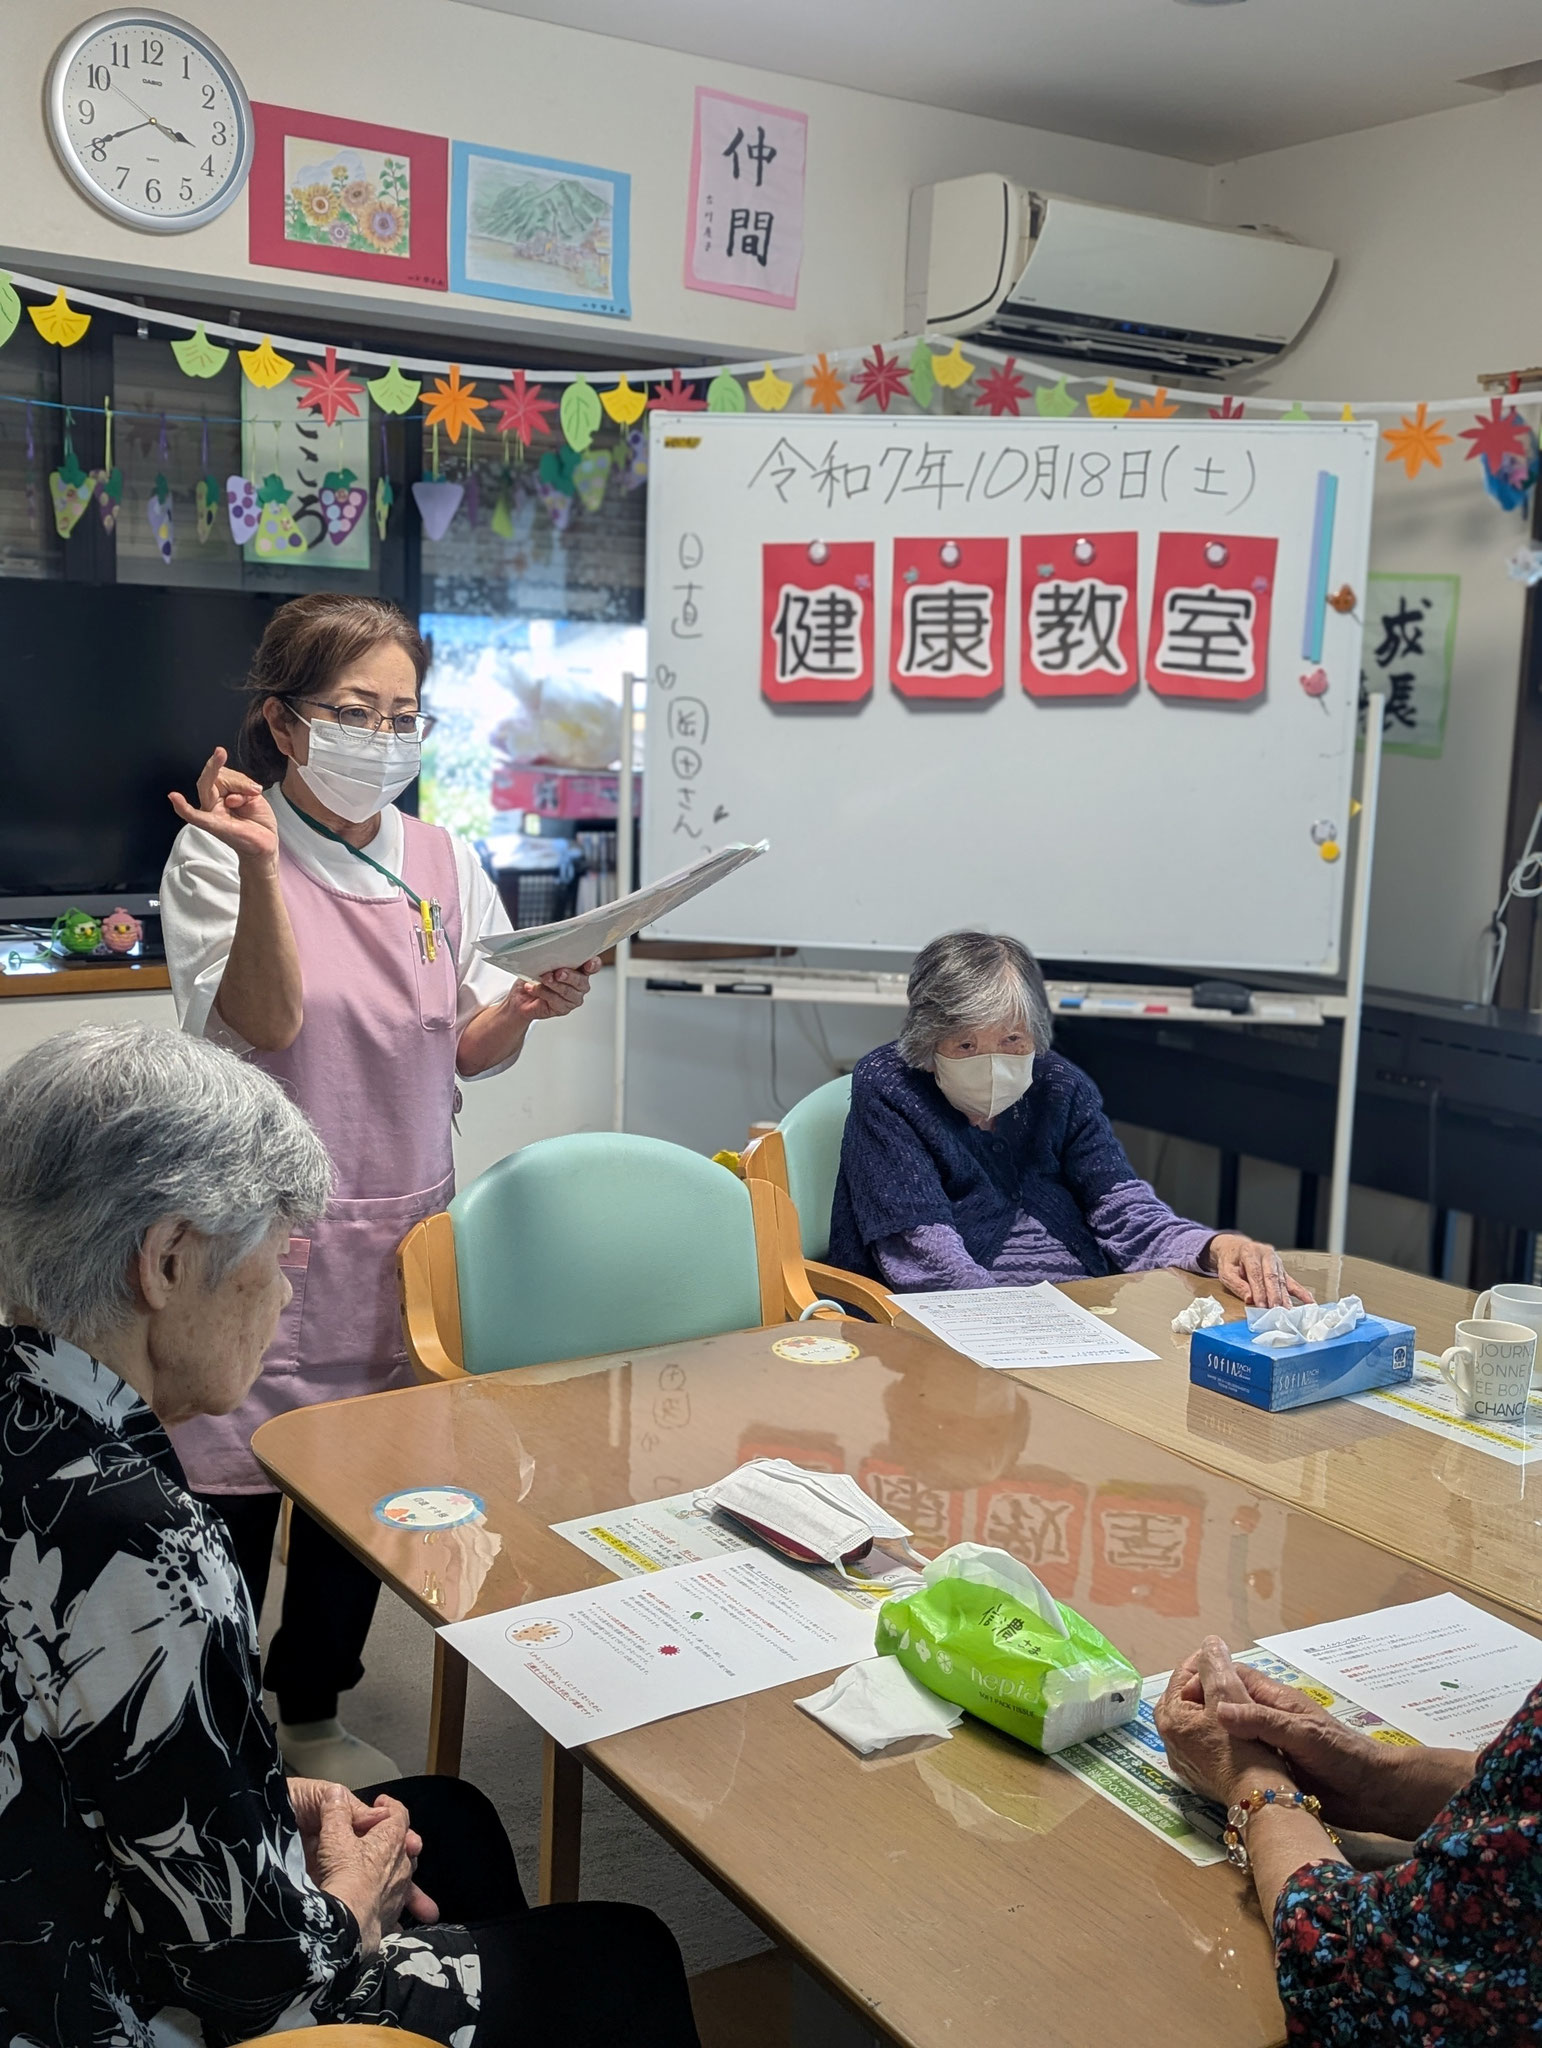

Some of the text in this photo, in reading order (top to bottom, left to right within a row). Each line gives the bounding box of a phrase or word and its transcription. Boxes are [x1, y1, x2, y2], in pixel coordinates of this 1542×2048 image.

[111, 41, 131, 69] 11
[141, 38, 164, 67] 12
[87, 63, 111, 91] 10
[181, 55, 191, 81] 1
[142, 78, 163, 87] CASIO
[201, 84, 216, 110] 2
[78, 99, 96, 125] 9
[211, 121, 228, 146] 3
[90, 137, 107, 162] 8
[115, 165, 131, 190] 7
[200, 154, 216, 178] 4
[145, 178, 162, 203] 6
[178, 177, 194, 200] 5
[722, 126, 778, 267] 仲間
[774, 583, 1252, 679] 健康教室
[1374, 596, 1433, 733] 成長
[971, 1666, 1041, 1704] nepia
